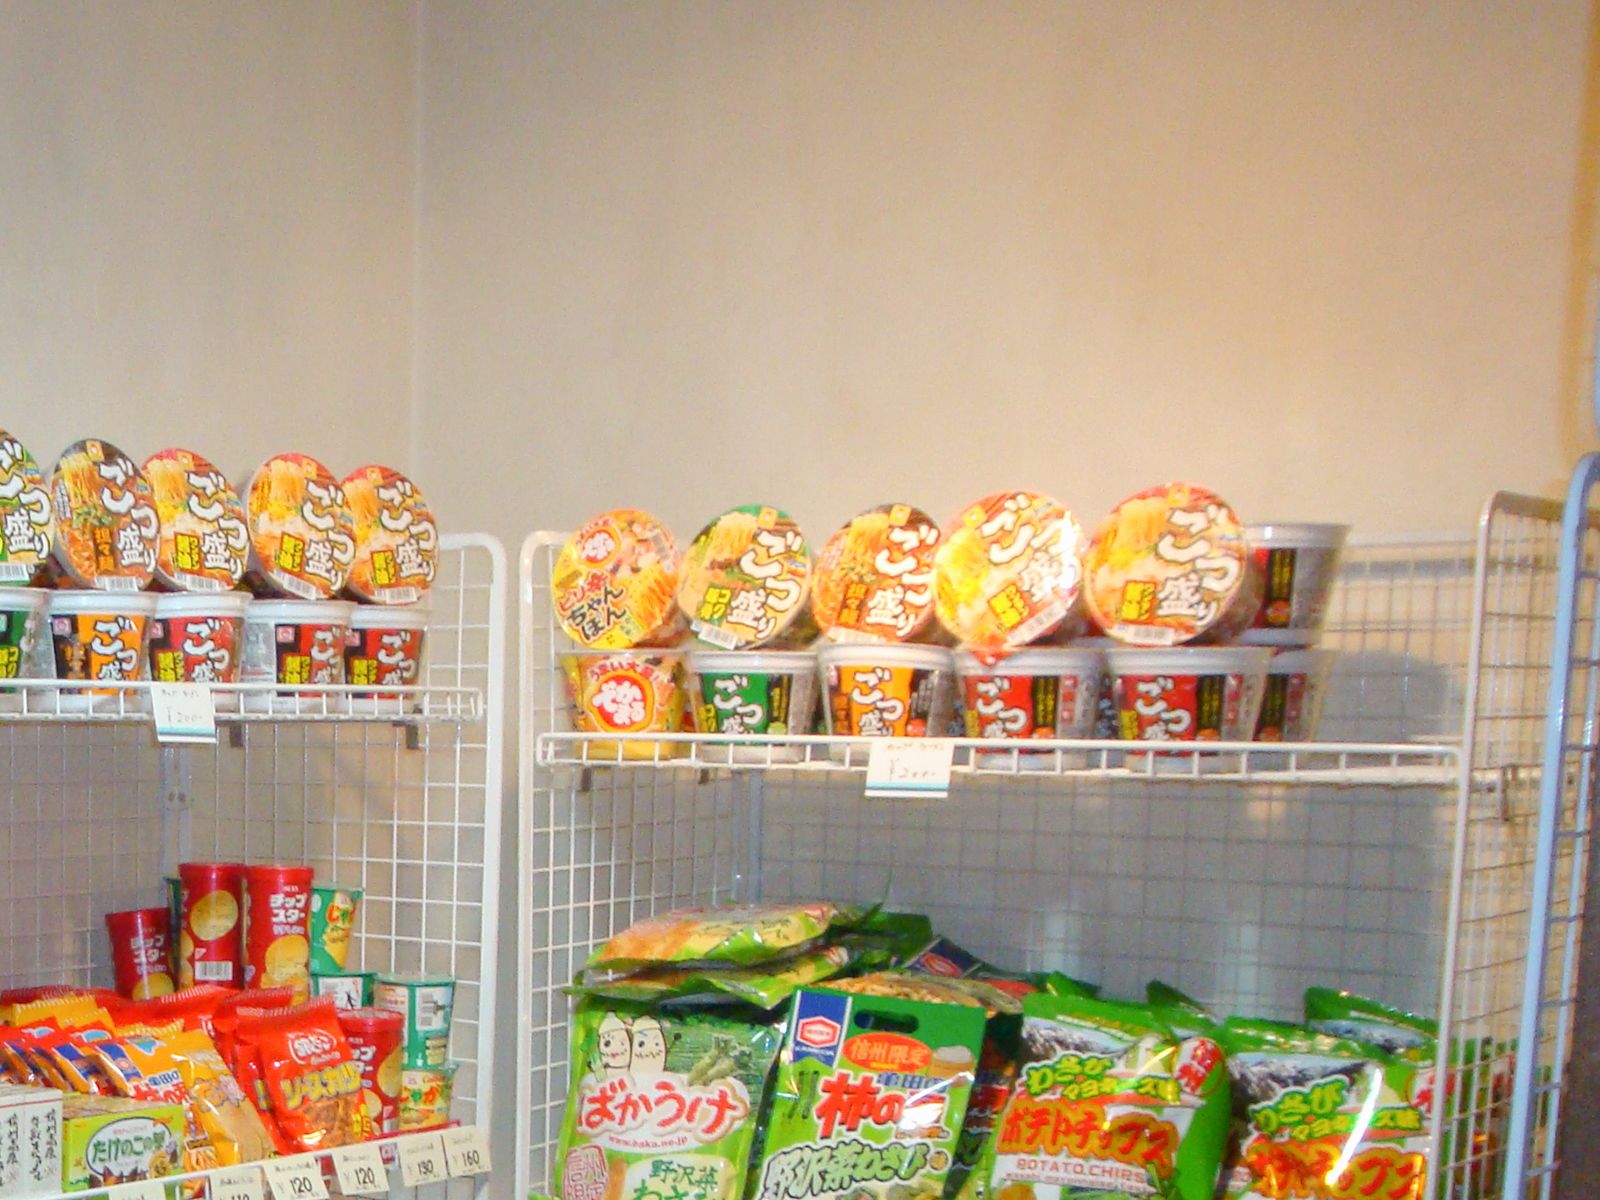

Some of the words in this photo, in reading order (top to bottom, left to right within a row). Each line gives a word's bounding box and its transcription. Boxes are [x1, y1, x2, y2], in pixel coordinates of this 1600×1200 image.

[727, 529, 804, 640] ごつ盛り
[1156, 502, 1241, 628] ごつ盛り
[91, 615, 138, 681] ごつ盛
[183, 616, 231, 682] ごつ盛
[376, 630, 418, 685] ごつ盛
[713, 674, 764, 734] ごつ盛
[976, 676, 1028, 738] ごつ盛
[1136, 676, 1192, 739] ごつ盛
[851, 1038, 926, 1066] 信州限定
[577, 1077, 738, 1136] ばかうけ
[815, 1070, 950, 1140] 柿の
[1001, 1103, 1172, 1179] ポテトチップス
[289, 1176, 313, 1194] 120
[354, 1167, 375, 1185] 120
